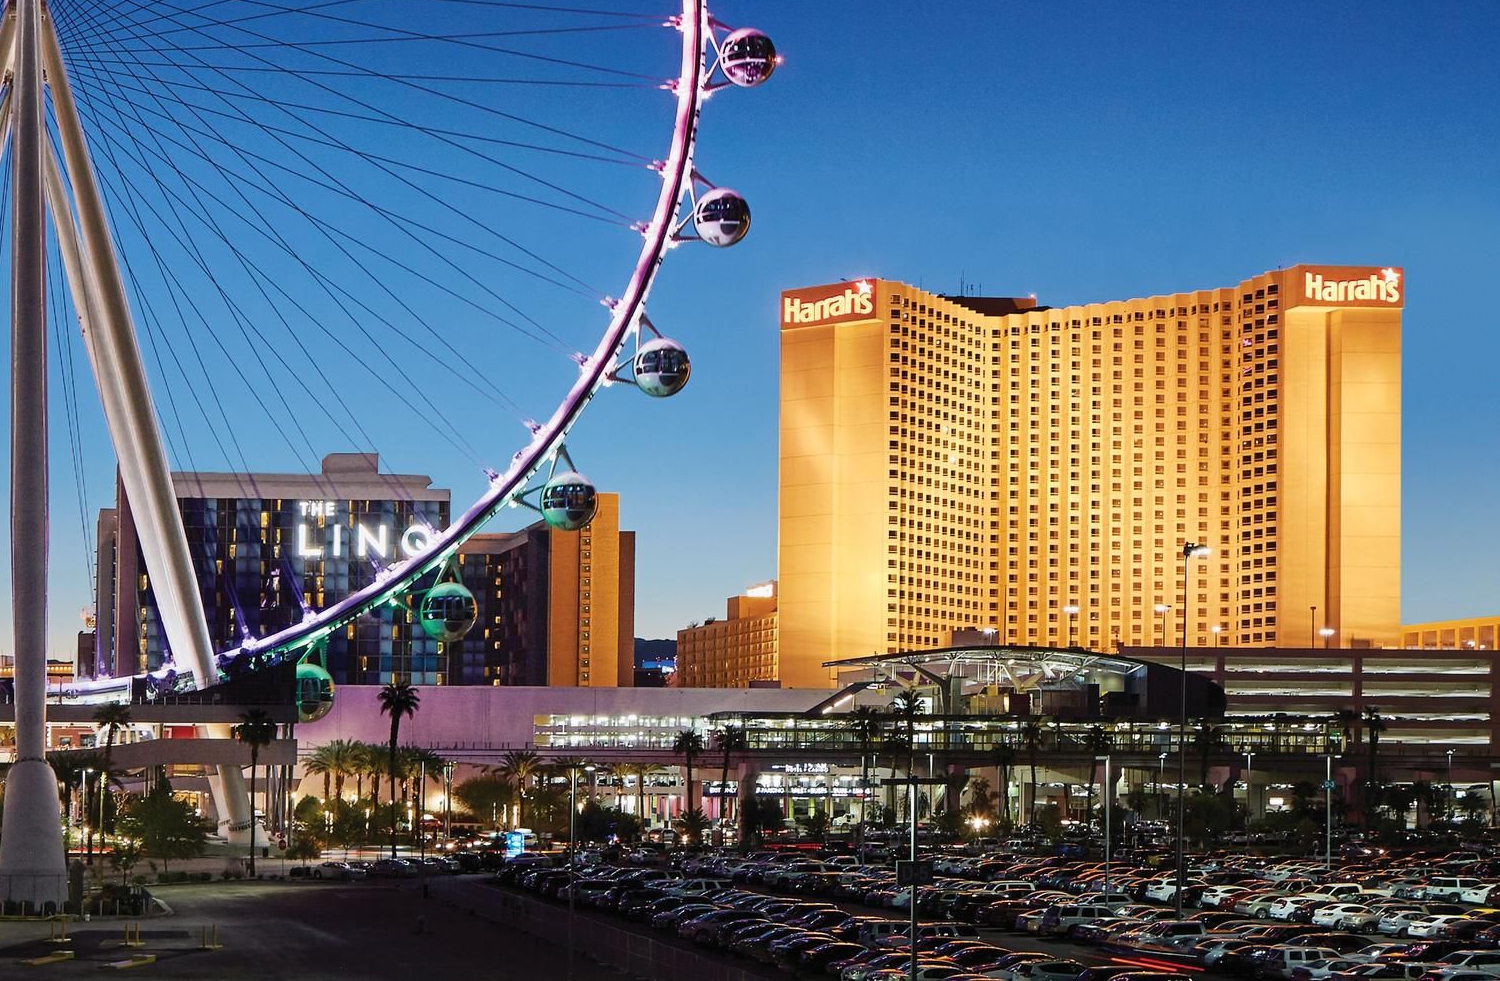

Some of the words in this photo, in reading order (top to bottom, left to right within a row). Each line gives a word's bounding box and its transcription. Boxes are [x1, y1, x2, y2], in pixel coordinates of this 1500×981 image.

[299, 501, 335, 517] THE
[298, 523, 430, 558] LINQ
[902, 865, 928, 881] D-5
